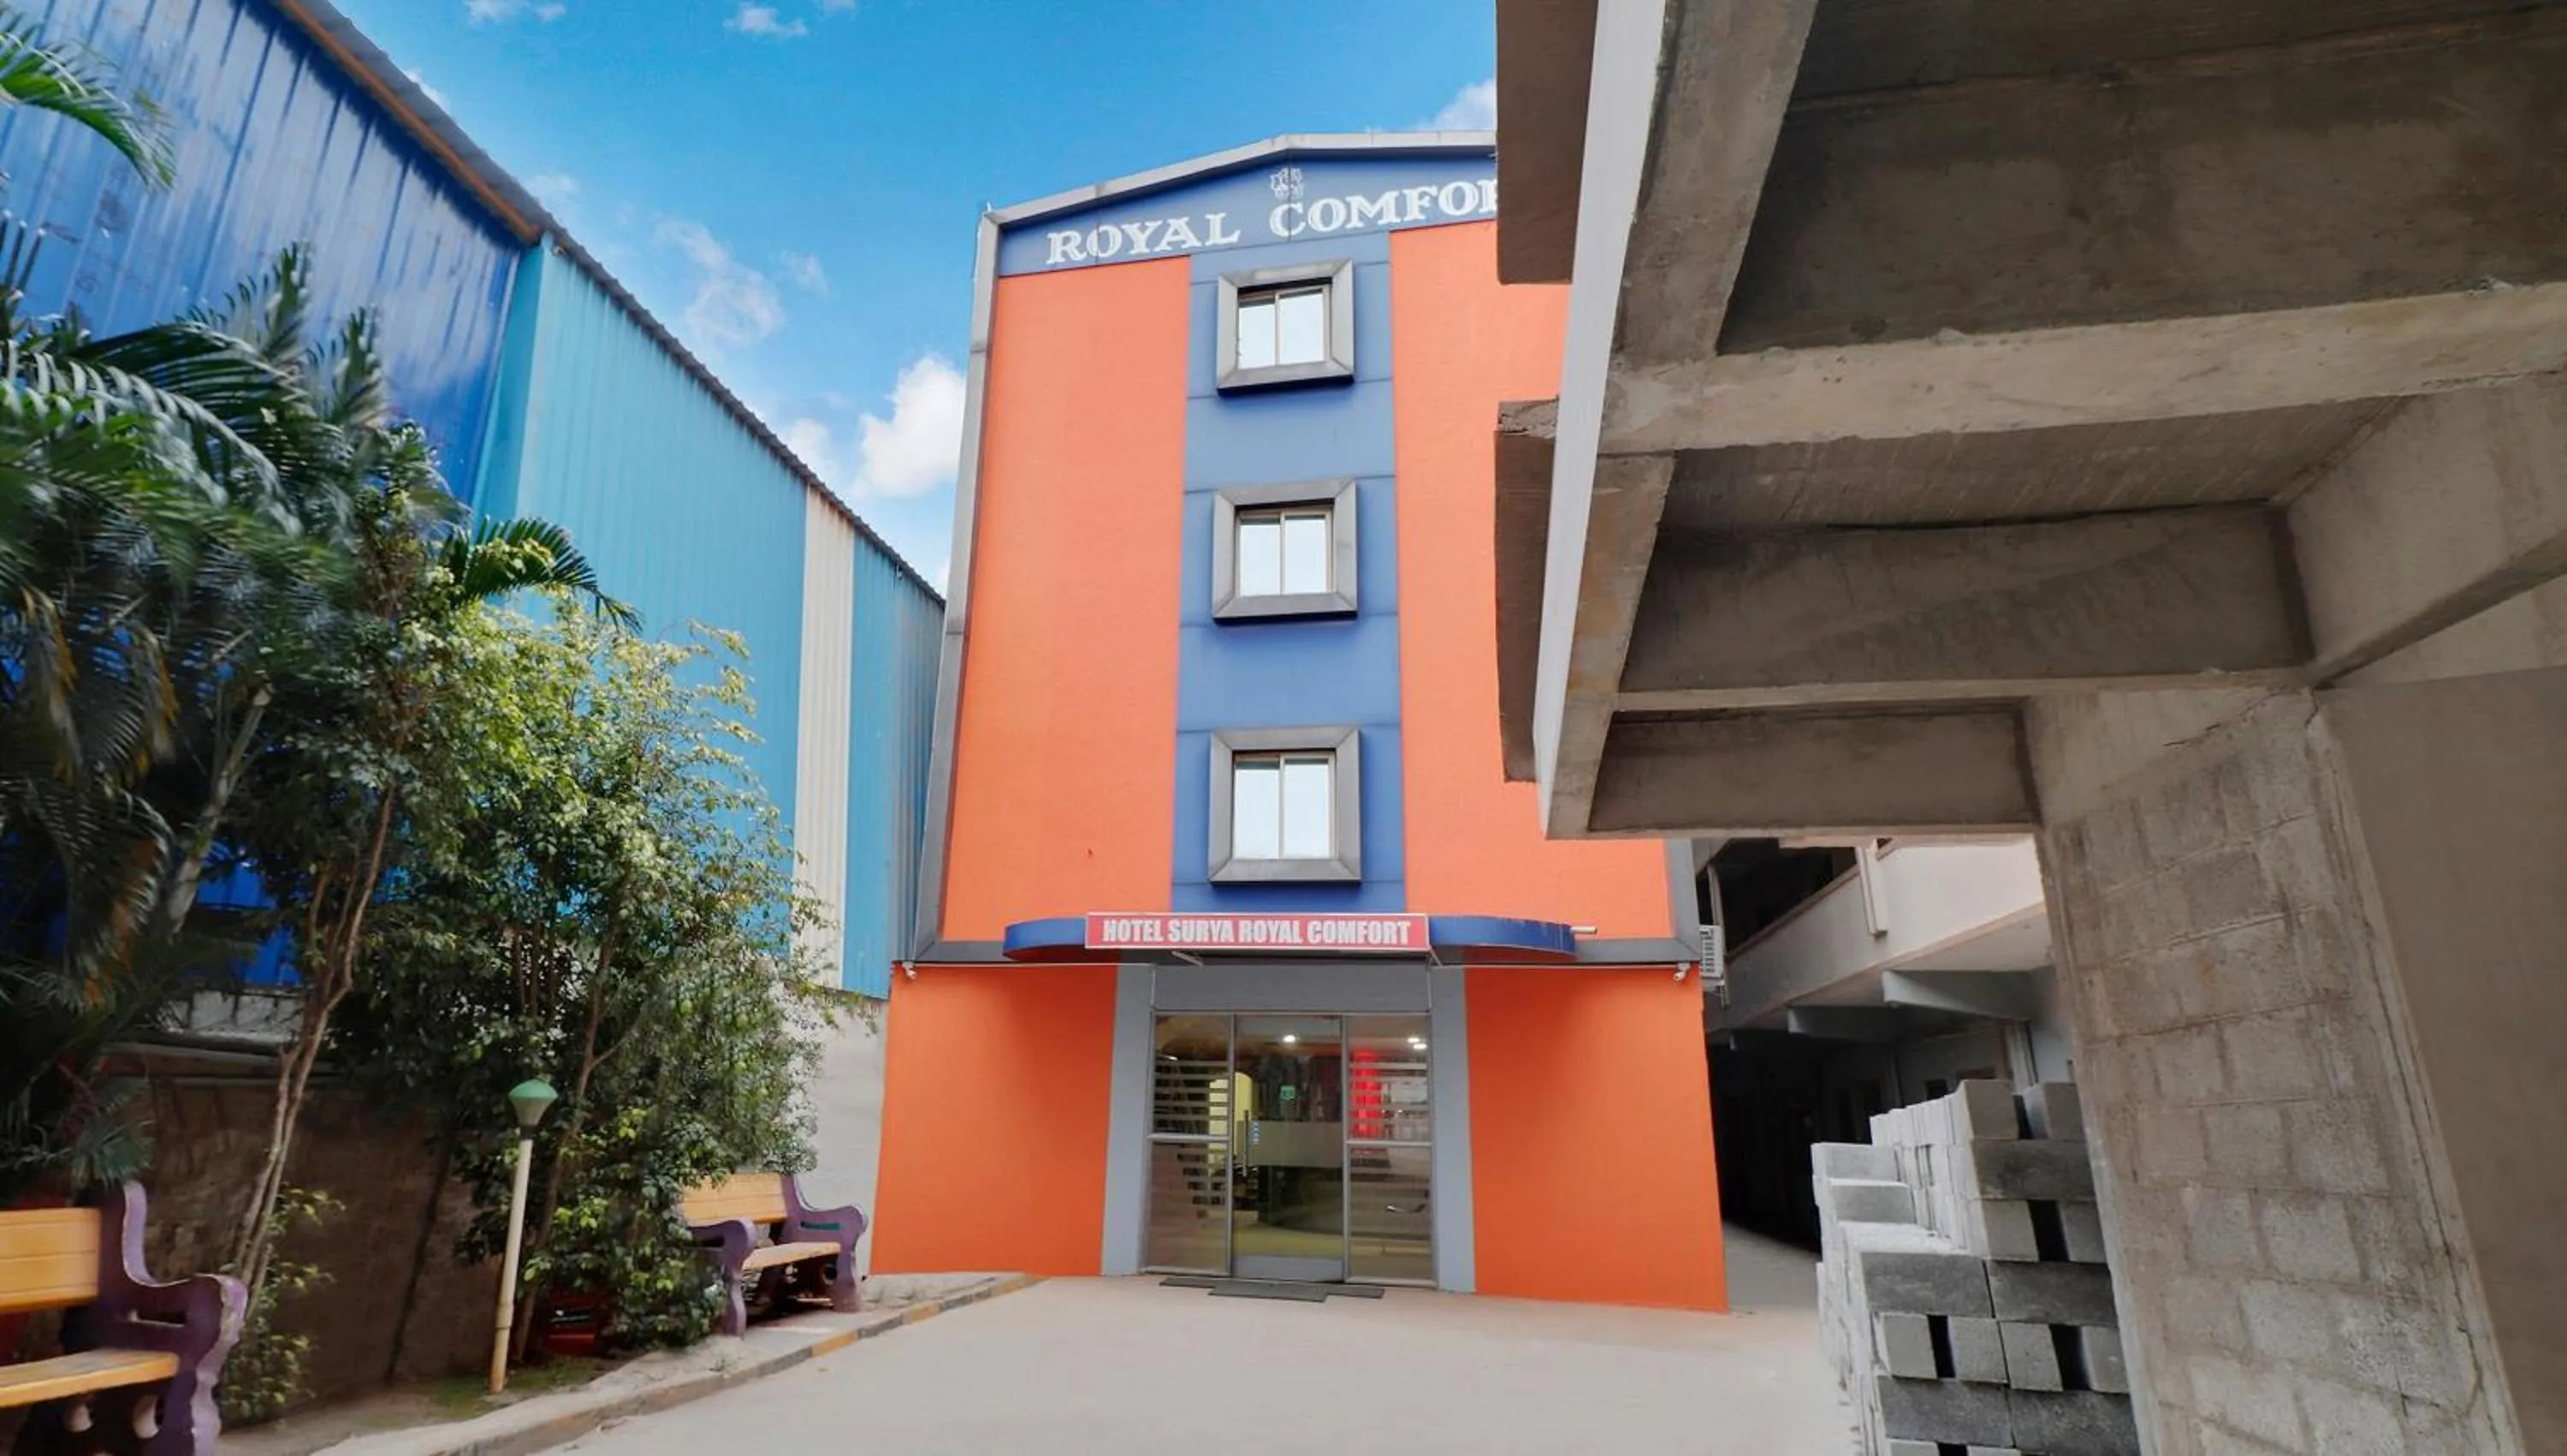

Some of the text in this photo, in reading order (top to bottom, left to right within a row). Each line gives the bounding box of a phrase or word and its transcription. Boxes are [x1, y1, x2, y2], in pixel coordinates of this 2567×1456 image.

[1046, 213, 1241, 264] ROYAL
[1102, 919, 1411, 946] HOTEL SURYA ROYAL COMFORT
